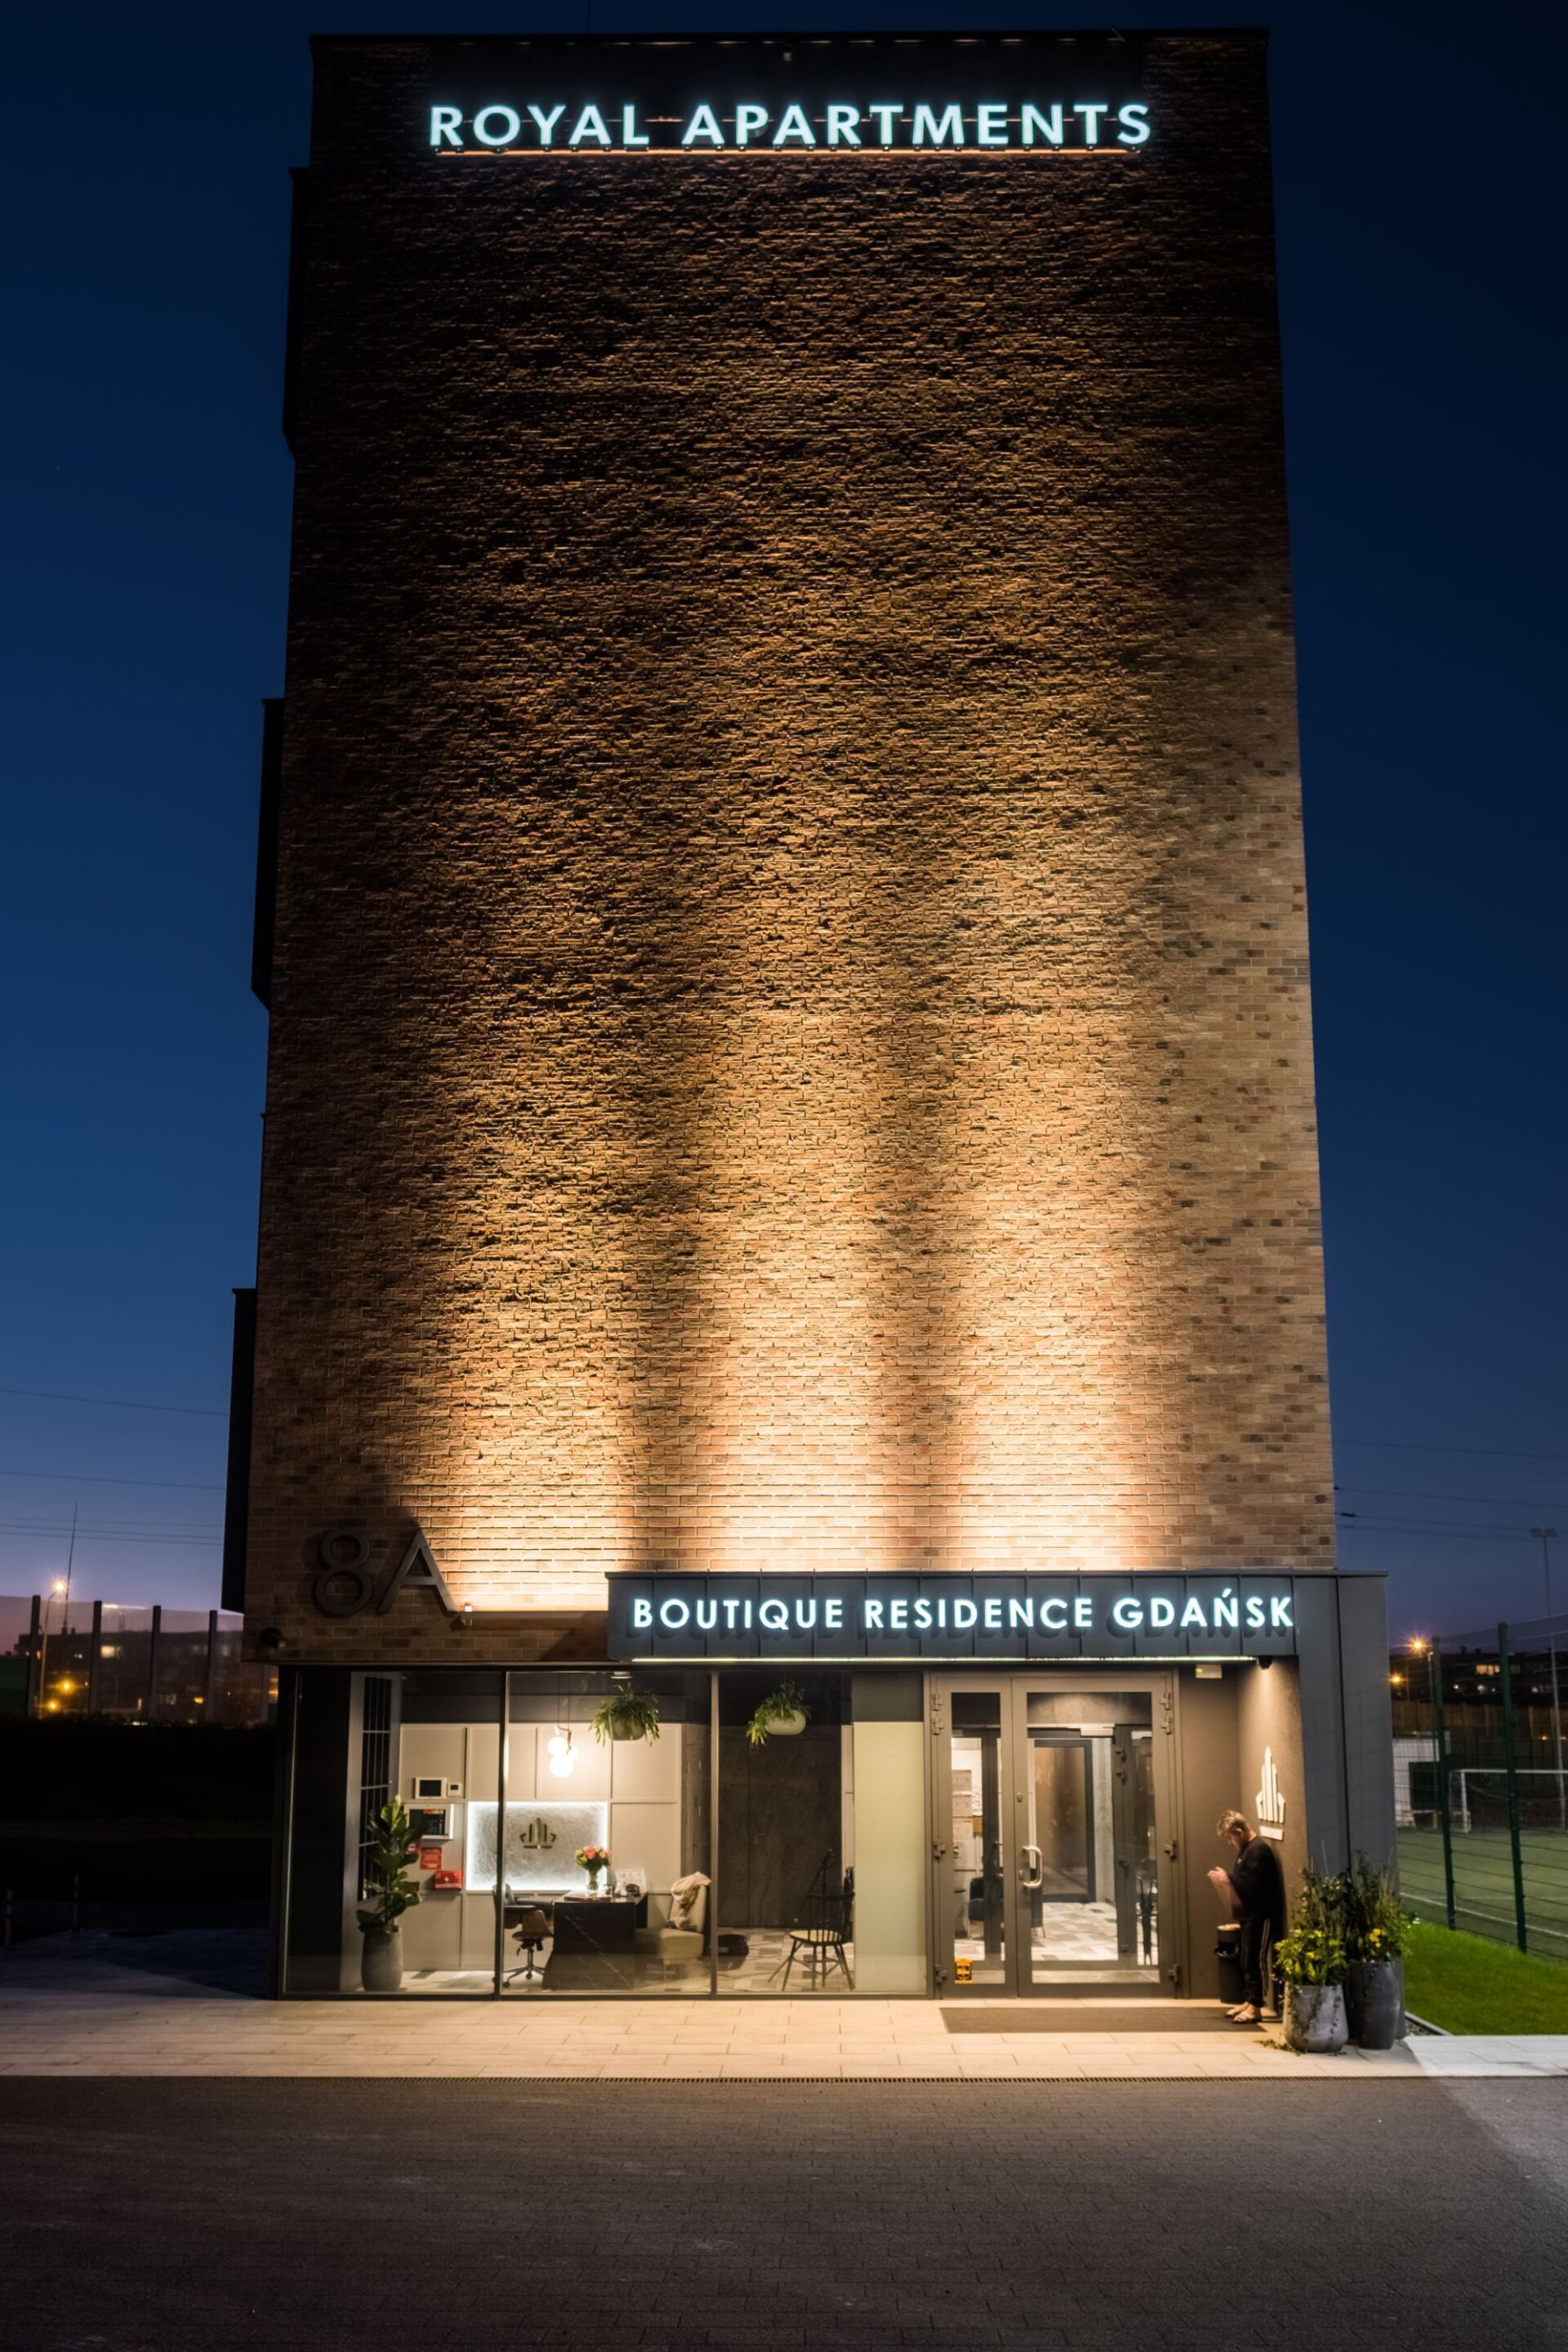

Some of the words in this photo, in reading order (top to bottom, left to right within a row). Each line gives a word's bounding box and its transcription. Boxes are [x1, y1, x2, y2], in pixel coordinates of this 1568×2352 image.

[430, 104, 650, 146] ROYAL
[681, 103, 1152, 146] APARTMENTS
[313, 1528, 458, 1616] 8A
[632, 1597, 844, 1631] BOUTIQUE
[863, 1596, 1094, 1630] RESIDENCE
[1111, 1586, 1294, 1630] GDAŃSK
